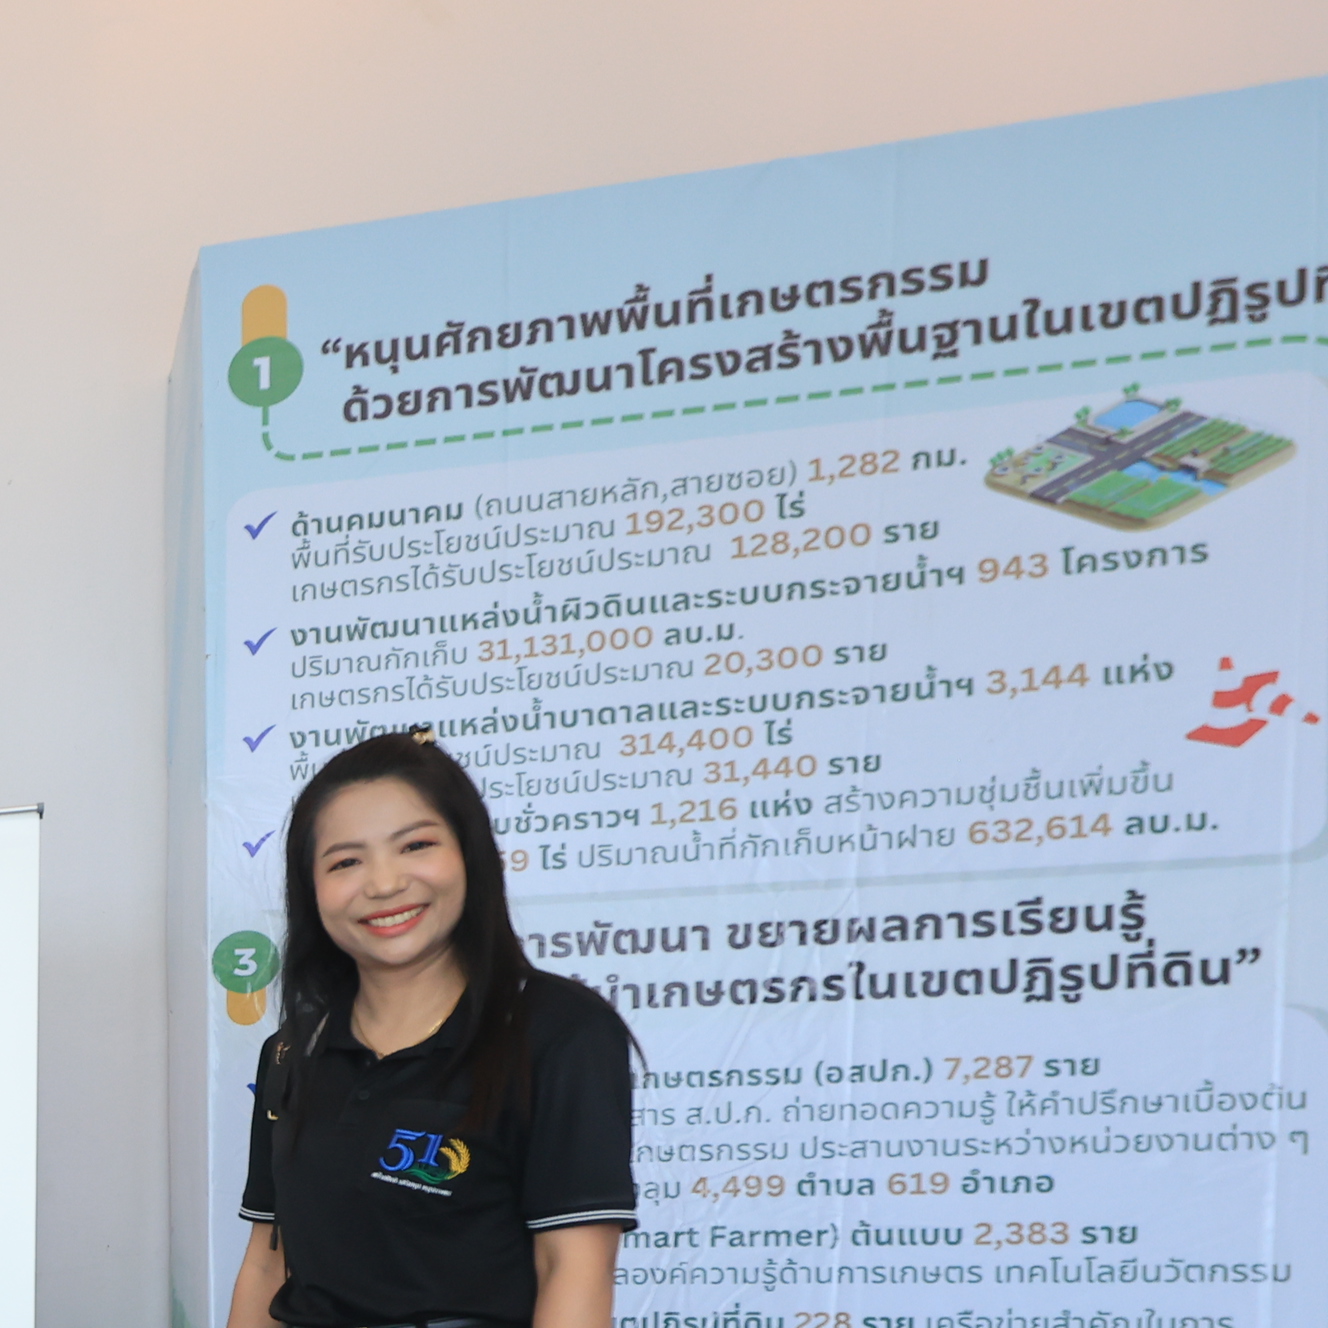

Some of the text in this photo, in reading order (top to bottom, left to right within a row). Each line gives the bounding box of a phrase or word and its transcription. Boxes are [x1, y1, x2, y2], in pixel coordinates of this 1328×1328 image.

[252, 355, 272, 390] 1
[291, 446, 968, 537] ด้านคมนาคม (ถนนสายหลัก,สายซอย) 1,282 กม.
[291, 491, 805, 571] พื้นที่รับประโยชน์ประมาณ 192,300 ไร่
[291, 518, 940, 603] เกษตรกรได้รับประโยชน์ประมาณ 128,200 ราย
[977, 552, 1050, 583] 943
[1061, 541, 1210, 576] โครงการ
[290, 619, 743, 680] ปริมาณกักเก็บ 31,131,000 ลบ.ม.
[290, 639, 888, 711] เกษตรกรได้รับประโยชน์ประมาณ 20,300 ราย
[986, 654, 1173, 697] 3,144 แห่ง
[619, 719, 793, 758] 314,400 ไร่
[703, 752, 883, 785] 31,440 ราย
[650, 762, 1173, 827] 1,216 แห่ง สร้างความชุ่มชื้นเพิ่มขึ้น
[540, 809, 1219, 872] ไร่ ปริมาณน้ำที่กักเก็บหน้าฝาย 632,614 ลบ.ม.
[233, 889, 1146, 976] 3 ขยายผลการเรียนรู้
[814, 1054, 1101, 1088] (อสปก.) 7,287 ราย
[686, 1078, 1308, 1129] ส.ป.ก. ถ่ายทอดความรู้ ให้คำปรึกษาเบื้องต้น
[378, 1128, 444, 1172] 51
[800, 1124, 1276, 1164] ประสานงานระหว่างหน่วยงานต่าง
[690, 1168, 1055, 1202] 4,499 ตำบล 619 อำเภอ
[710, 1219, 1138, 1252] Farmer) ต้นแบบ 2,383 ราย
[995, 1250, 1292, 1288] เทคโนโลยีนวัตกรรม
